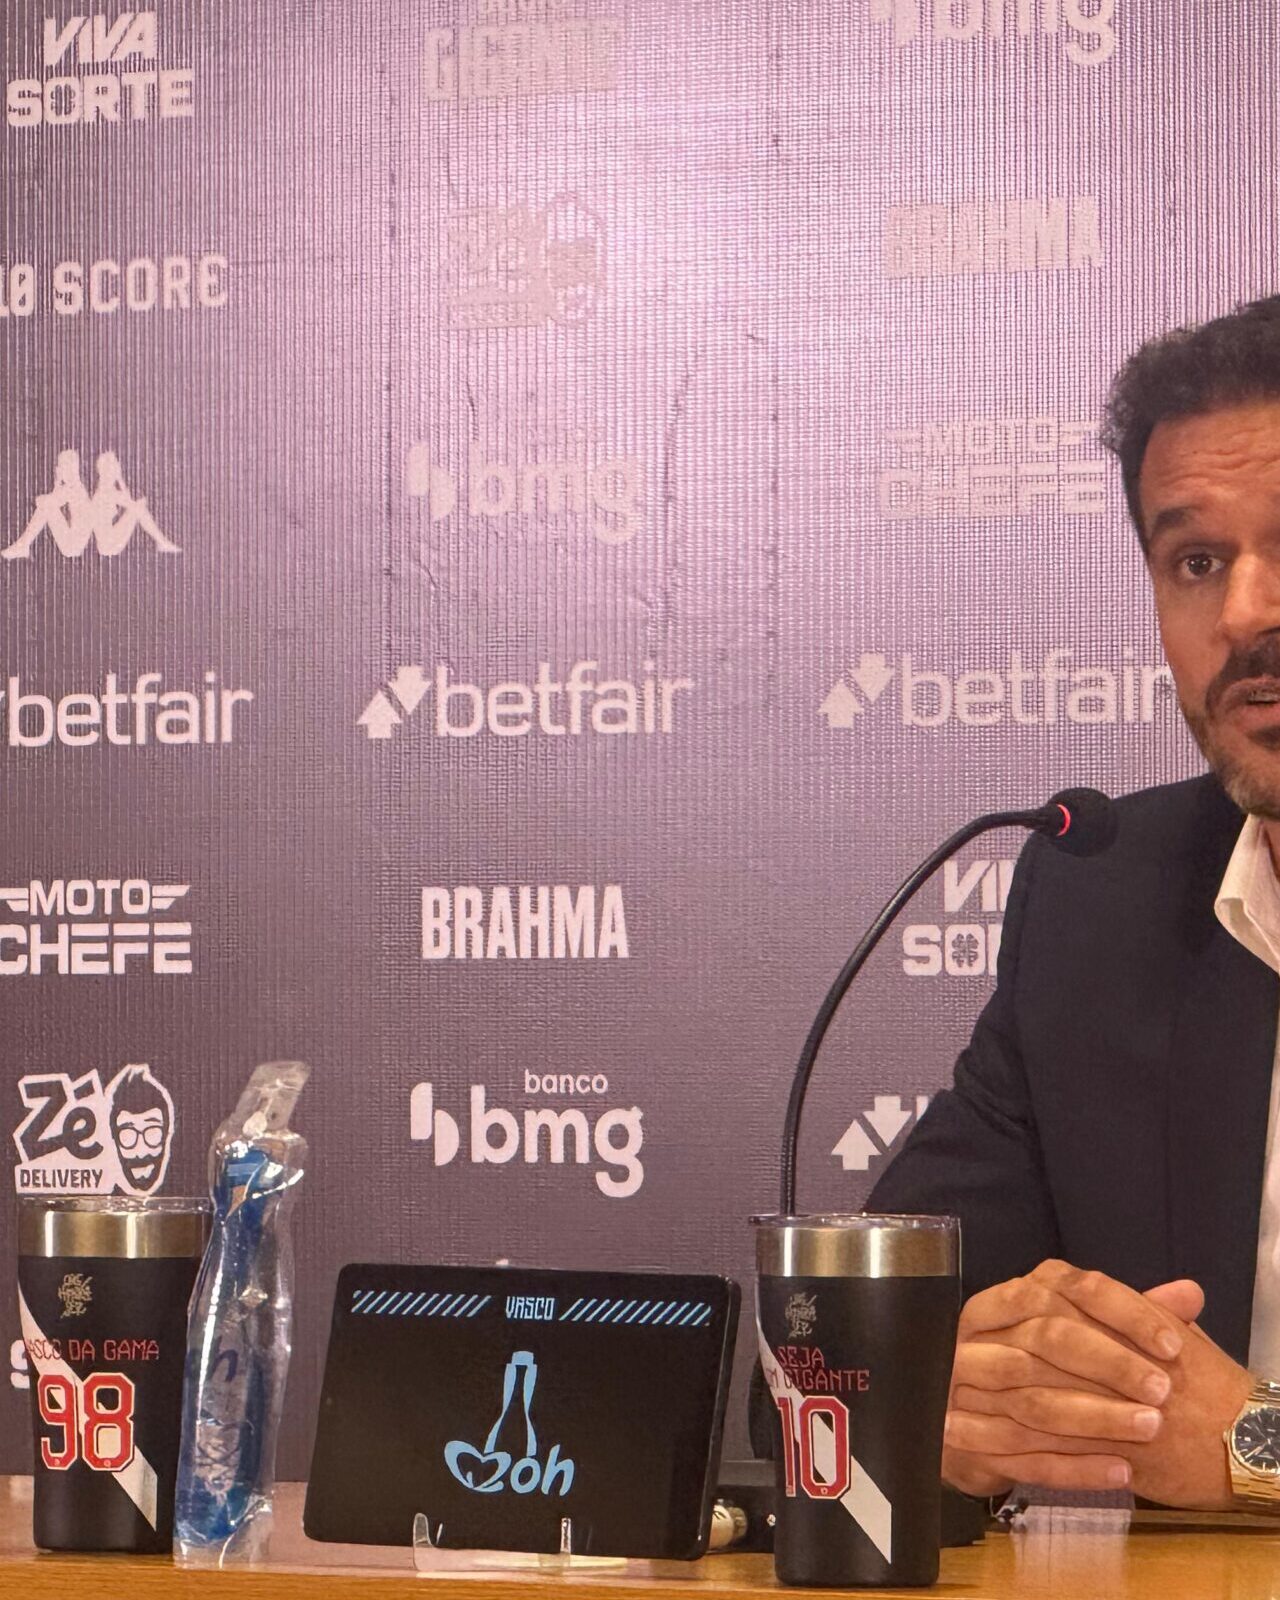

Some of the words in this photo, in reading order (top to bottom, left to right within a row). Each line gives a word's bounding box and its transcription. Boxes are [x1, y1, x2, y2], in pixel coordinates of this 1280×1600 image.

[44, 11, 157, 66] VIVA
[7, 68, 194, 127] SORTE
[884, 196, 1103, 279] BRAHMA
[53, 253, 228, 315] SCORE
[924, 417, 1056, 456] MOTO
[469, 442, 642, 545] bmg
[880, 460, 1105, 520] CHEFE
[8, 671, 254, 748] betfair
[436, 660, 692, 738] betfair
[902, 646, 1174, 729] betfair
[29, 879, 151, 916] MOTO
[421, 884, 630, 960] BRAHMA
[0, 922, 193, 975] CHEFE
[524, 1069, 608, 1094] banco
[470, 1084, 645, 1198] bmg
[19, 1168, 103, 1189] DELIVERY
[505, 1296, 555, 1321] VASCO
[68, 1339, 96, 1362] DA
[103, 1339, 160, 1361] GAMA
[777, 1345, 826, 1369] SEJA
[783, 1368, 870, 1392] GIGANTE
[37, 1372, 136, 1472] 98
[776, 1395, 851, 1500] 10
